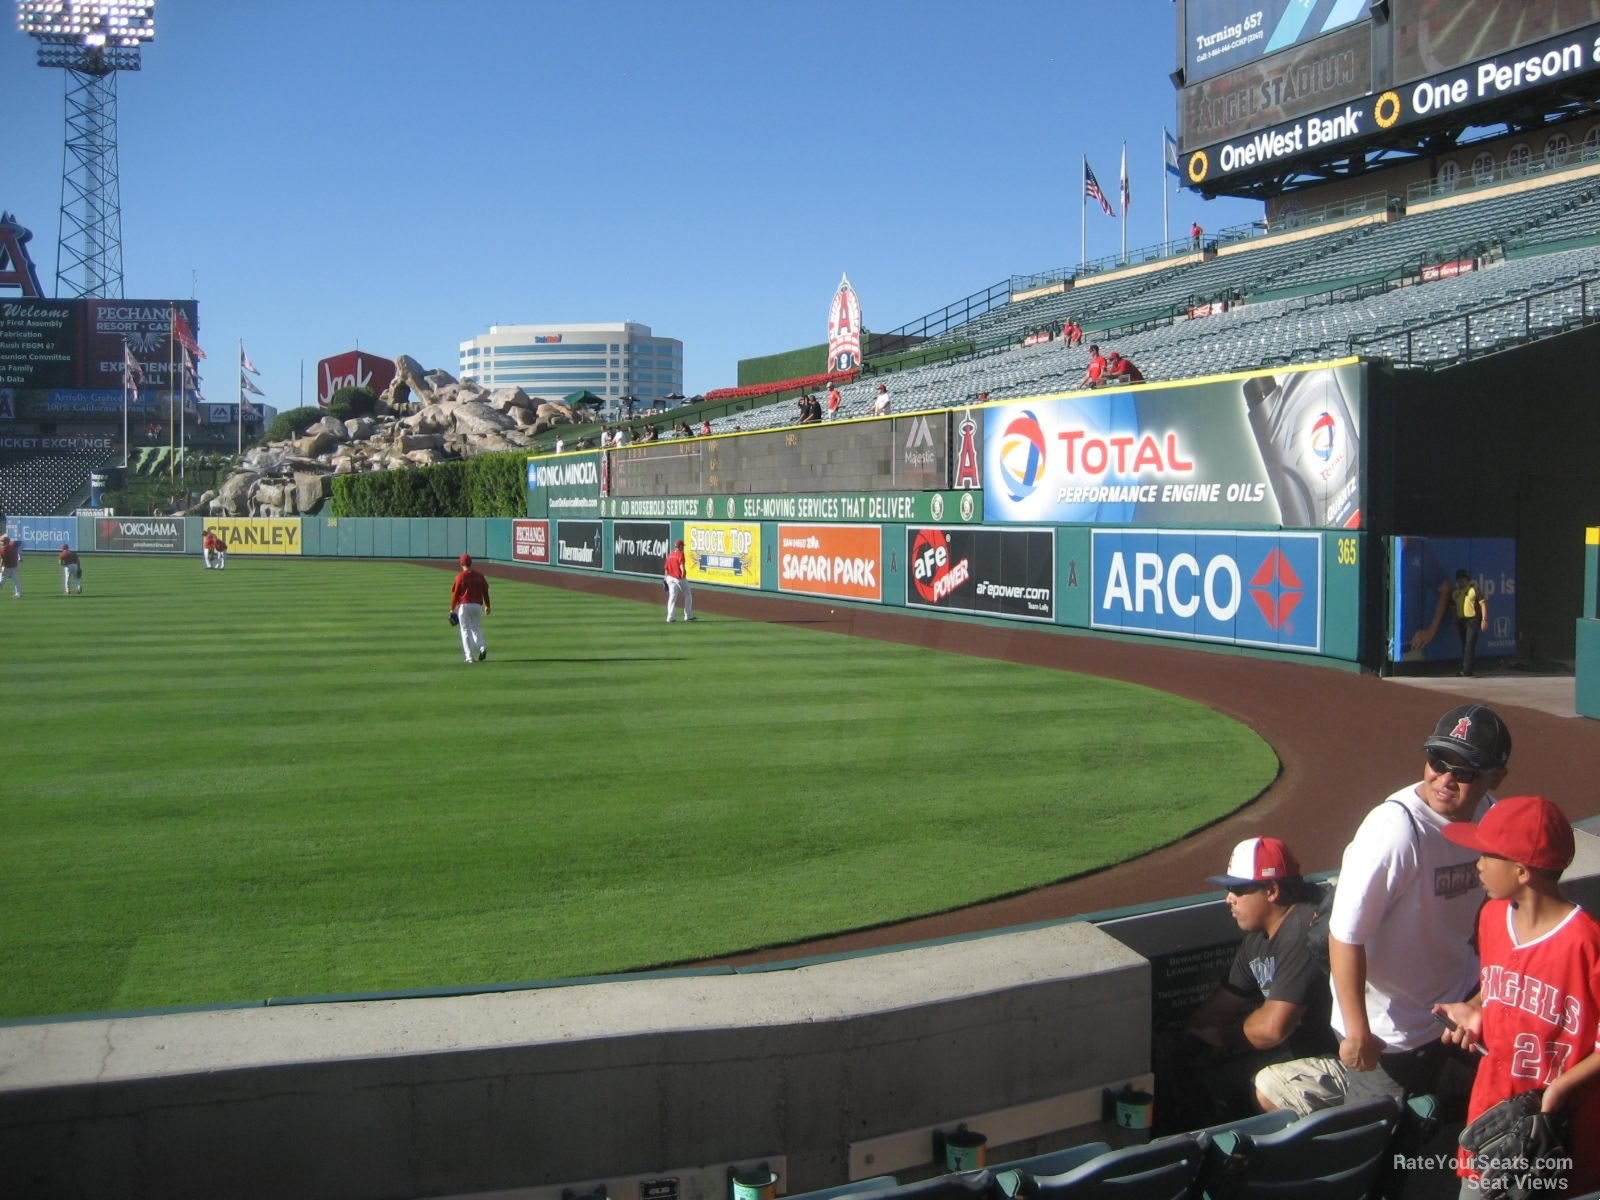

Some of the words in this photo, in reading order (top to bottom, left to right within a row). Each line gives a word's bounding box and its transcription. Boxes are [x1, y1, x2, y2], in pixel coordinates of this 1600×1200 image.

[1196, 24, 1242, 50] Turning
[1243, 11, 1263, 31] 65?
[1198, 88, 1258, 132] ANGEL
[1260, 50, 1355, 111] STADIUM
[1412, 82, 1468, 114] One
[1477, 44, 1582, 97] Person
[1220, 124, 1303, 172] OneWest
[1307, 107, 1360, 147] Bank
[3, 303, 70, 318] Welcome
[27, 320, 63, 328] Assembly
[96, 322, 138, 330] RESORT
[8, 365, 33, 373] Family
[29, 353, 71, 361] Committee
[320, 358, 373, 404] Jack
[905, 450, 935, 469] Majestic
[1058, 429, 1193, 476] TOTAL
[536, 465, 564, 487] KONICA
[565, 461, 598, 485] MINOLTA
[1057, 485, 1157, 506] PERFORMANCE
[1161, 484, 1220, 503] ENGINE
[1226, 482, 1267, 502] OILS
[630, 500, 665, 515] HOUSEHOLD
[666, 499, 697, 515] SERVICES
[744, 499, 795, 517] SELF-MOVING
[798, 498, 838, 518] SERVICES
[841, 497, 865, 518] THAT
[23, 526, 70, 544] Experian
[119, 523, 177, 536] YOKOHAMA
[516, 526, 545, 542] PECHANGA
[690, 527, 724, 552] SHOCK
[729, 528, 753, 554] TOP
[559, 539, 594, 563] Thermador
[615, 535, 634, 555] NITTO
[1337, 539, 1356, 565] 365
[783, 553, 831, 583] SAFARI
[833, 555, 876, 588] PARK
[914, 545, 948, 580] aFe
[934, 558, 970, 603] POWER
[1103, 551, 1242, 621] ARCO
[1501, 573, 1516, 594] is
[1511, 1032, 1572, 1086] 27
